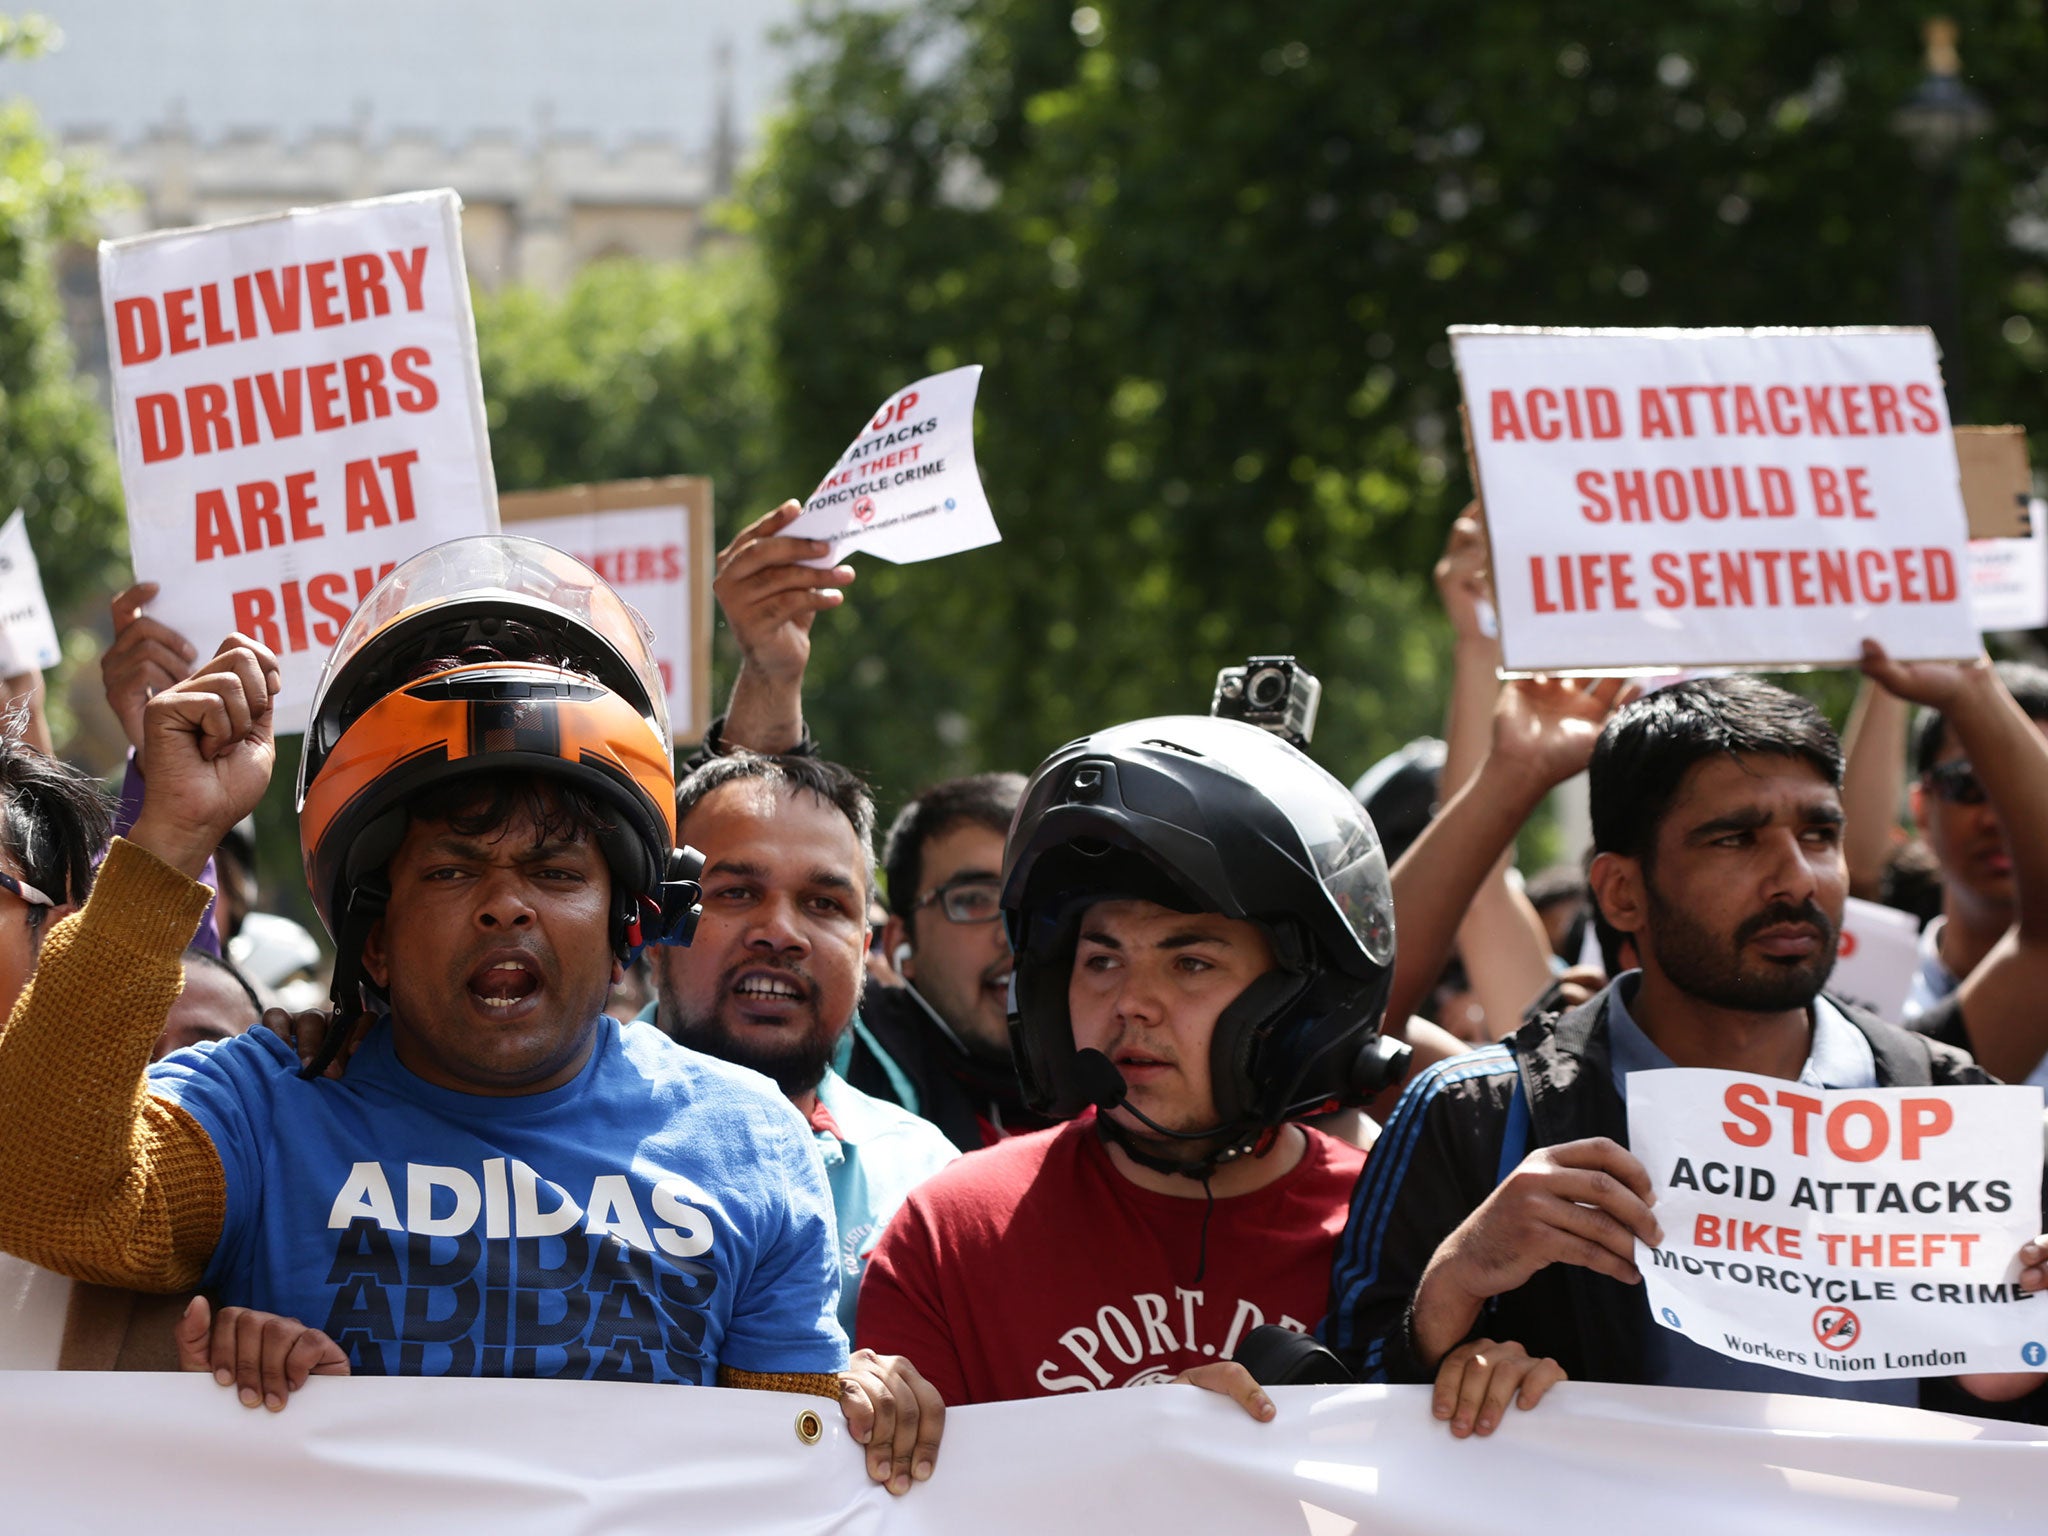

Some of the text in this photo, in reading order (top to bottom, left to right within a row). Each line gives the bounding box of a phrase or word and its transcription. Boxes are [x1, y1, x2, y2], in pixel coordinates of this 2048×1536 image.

[115, 246, 429, 367] DELIVERY
[136, 346, 440, 465] DRIVERS
[1490, 383, 1940, 441] ACID ATTACKERS
[859, 443, 923, 478] THEFT
[894, 458, 947, 487] CRIME
[195, 450, 419, 563] ARE AT
[1576, 466, 1878, 522] SHOULD BE
[1529, 548, 1958, 614] LIFE SENTENCED
[1721, 1082, 1954, 1163] STOP
[327, 1157, 714, 1258] ADIDAS
[1669, 1157, 2012, 1214] ACID ATTACKS
[326, 1217, 718, 1306] ADIDAS
[1694, 1213, 1980, 1267] BIKE THEFT
[1651, 1247, 2035, 1304] MOTORCYCLE CRIME
[325, 1274, 712, 1358] ADIDAS
[1723, 1333, 1967, 1372] Workers Union London
